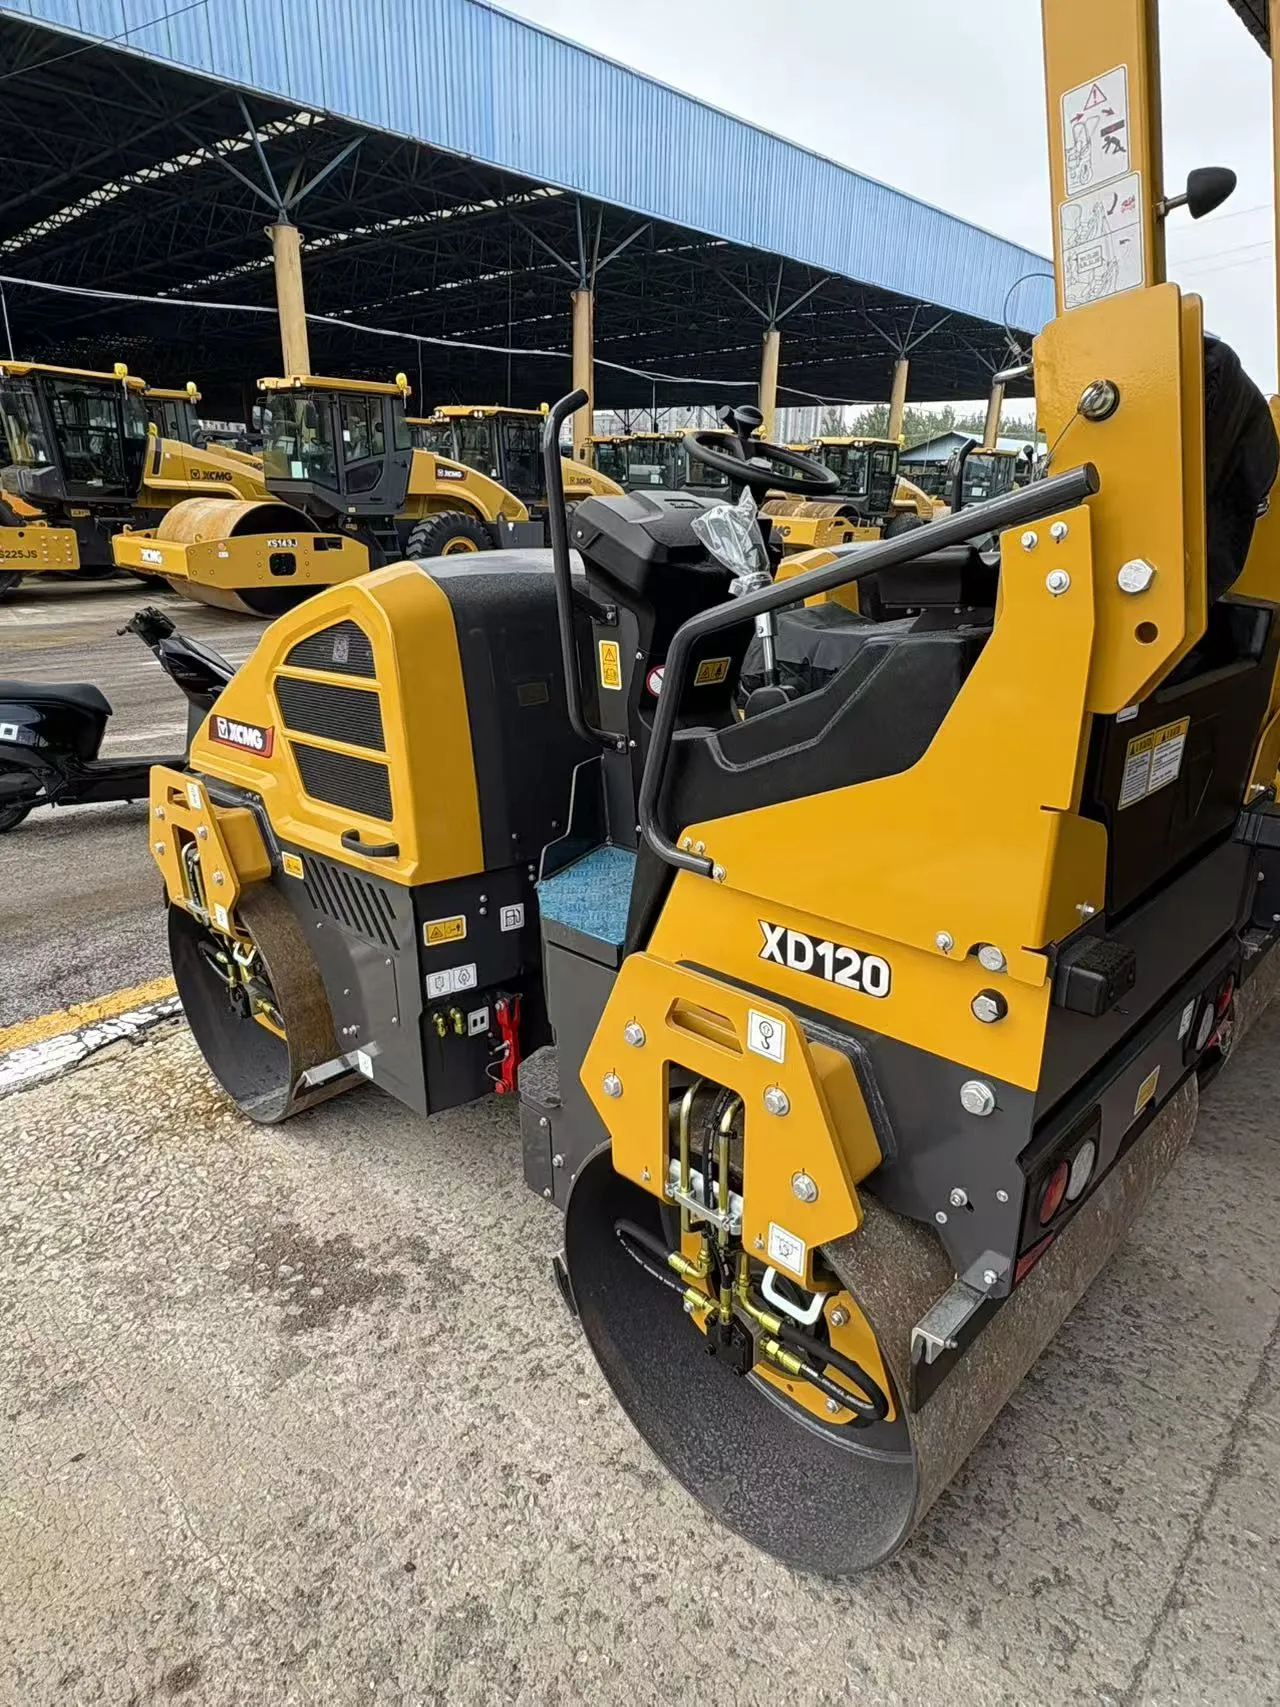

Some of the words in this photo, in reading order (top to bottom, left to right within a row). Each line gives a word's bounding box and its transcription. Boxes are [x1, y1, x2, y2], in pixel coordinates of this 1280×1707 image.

[201, 470, 233, 481] XCMG
[227, 721, 263, 750] XCMG
[758, 919, 891, 998] XD120
